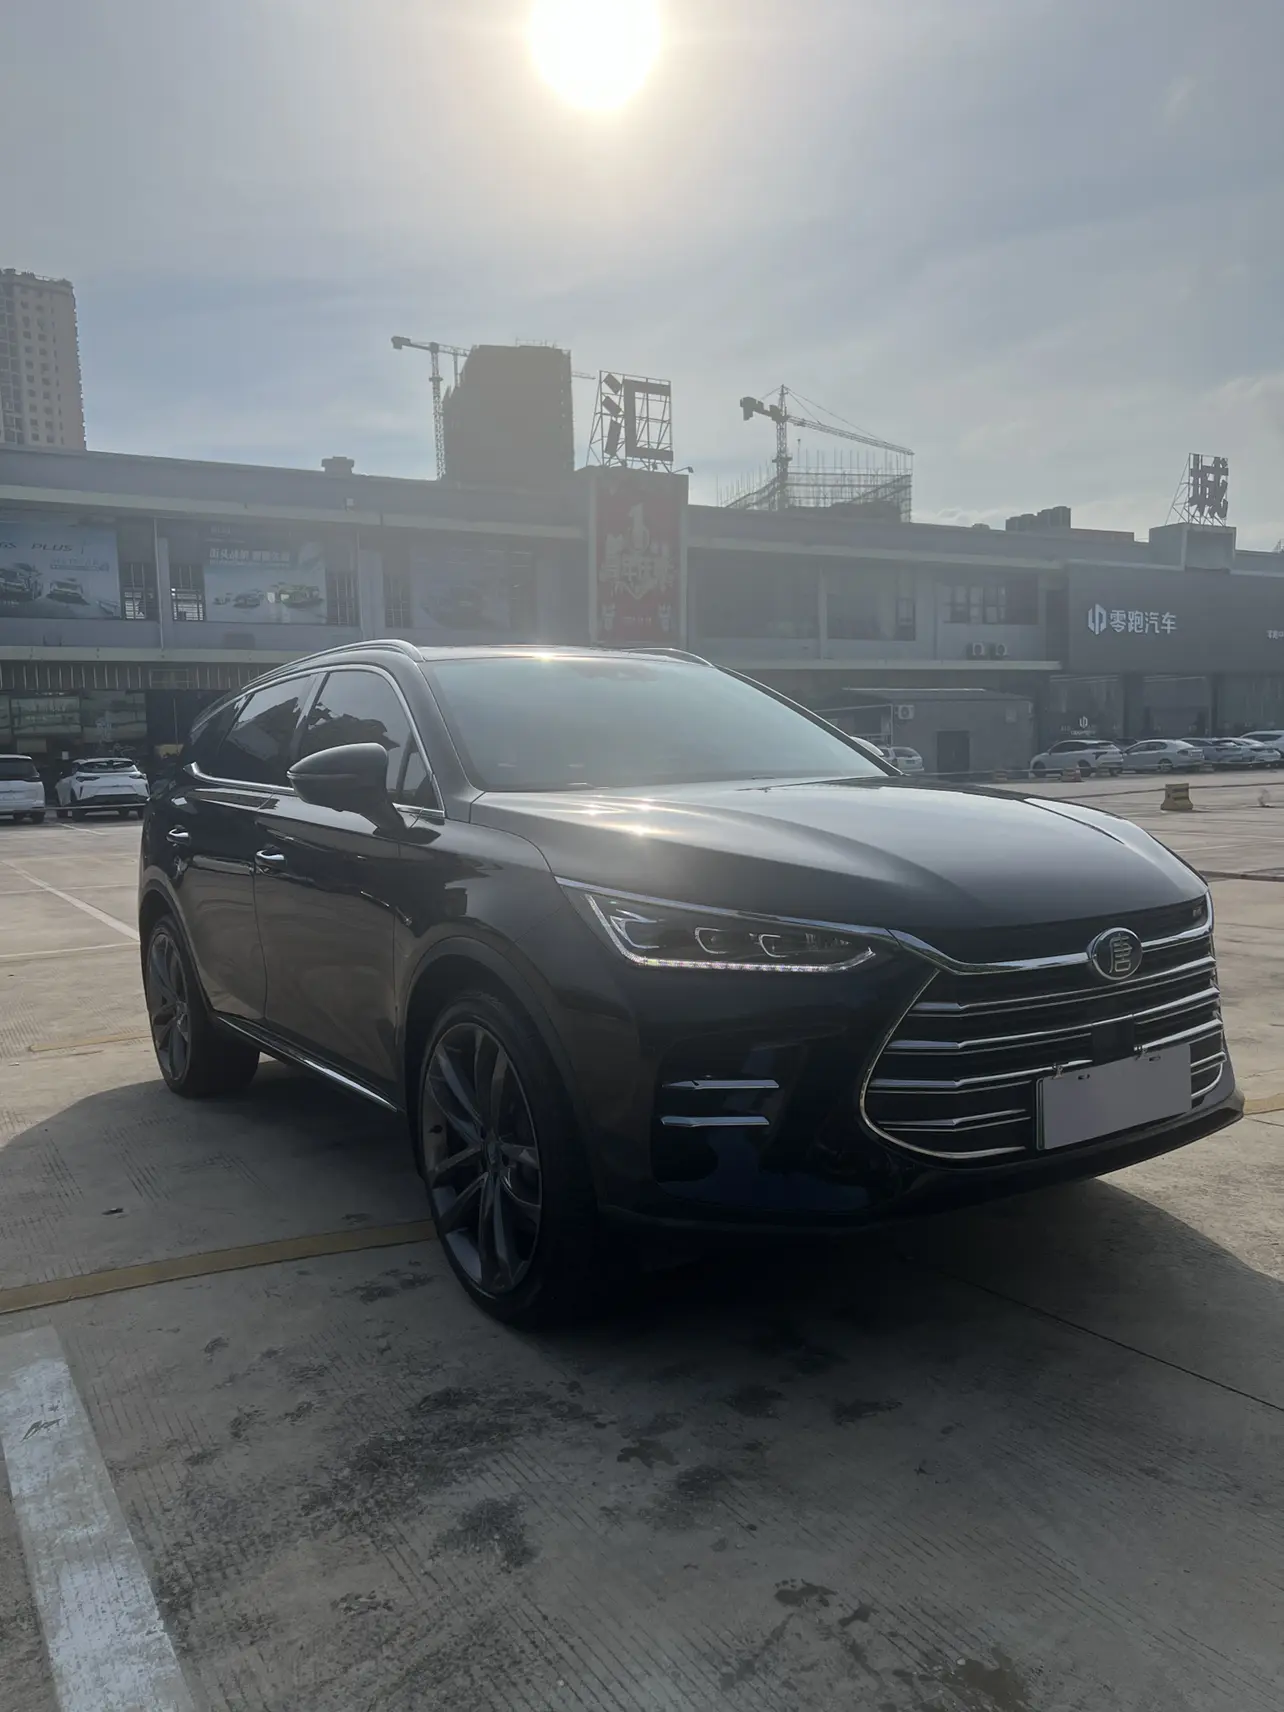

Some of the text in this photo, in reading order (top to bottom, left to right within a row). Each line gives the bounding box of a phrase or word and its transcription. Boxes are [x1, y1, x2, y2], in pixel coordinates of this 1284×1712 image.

[31, 541, 74, 552] PLUS
[1109, 609, 1178, 635] 零跑汽车
[1108, 933, 1134, 974] 唐
